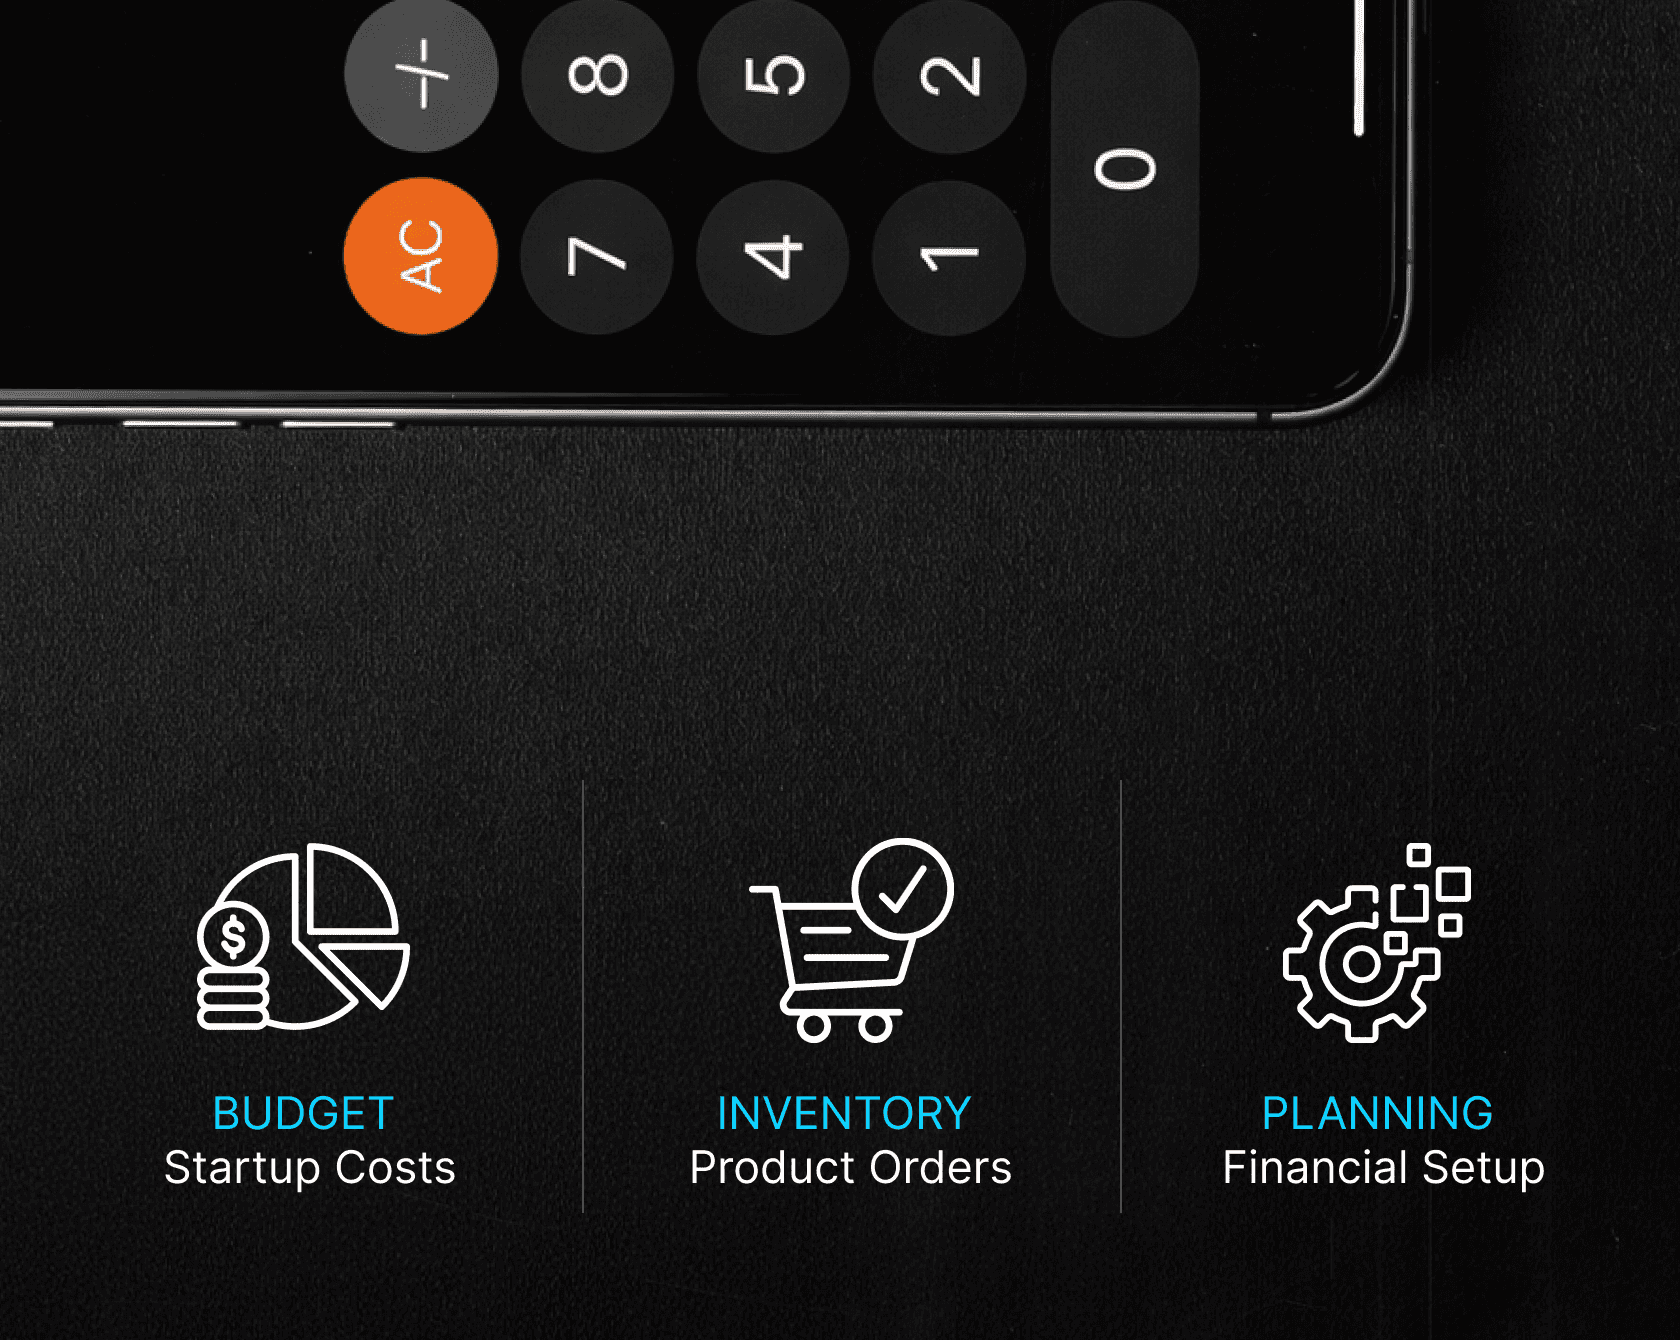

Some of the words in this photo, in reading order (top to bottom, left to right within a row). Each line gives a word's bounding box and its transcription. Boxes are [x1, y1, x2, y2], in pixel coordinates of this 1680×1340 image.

[568, 53, 628, 96] 8
[745, 55, 805, 96] 5
[920, 56, 981, 97] 2
[1093, 147, 1157, 190] 0
[398, 219, 443, 295] AC
[567, 237, 627, 277] 7
[744, 234, 803, 280] 4
[920, 248, 980, 272] 1
